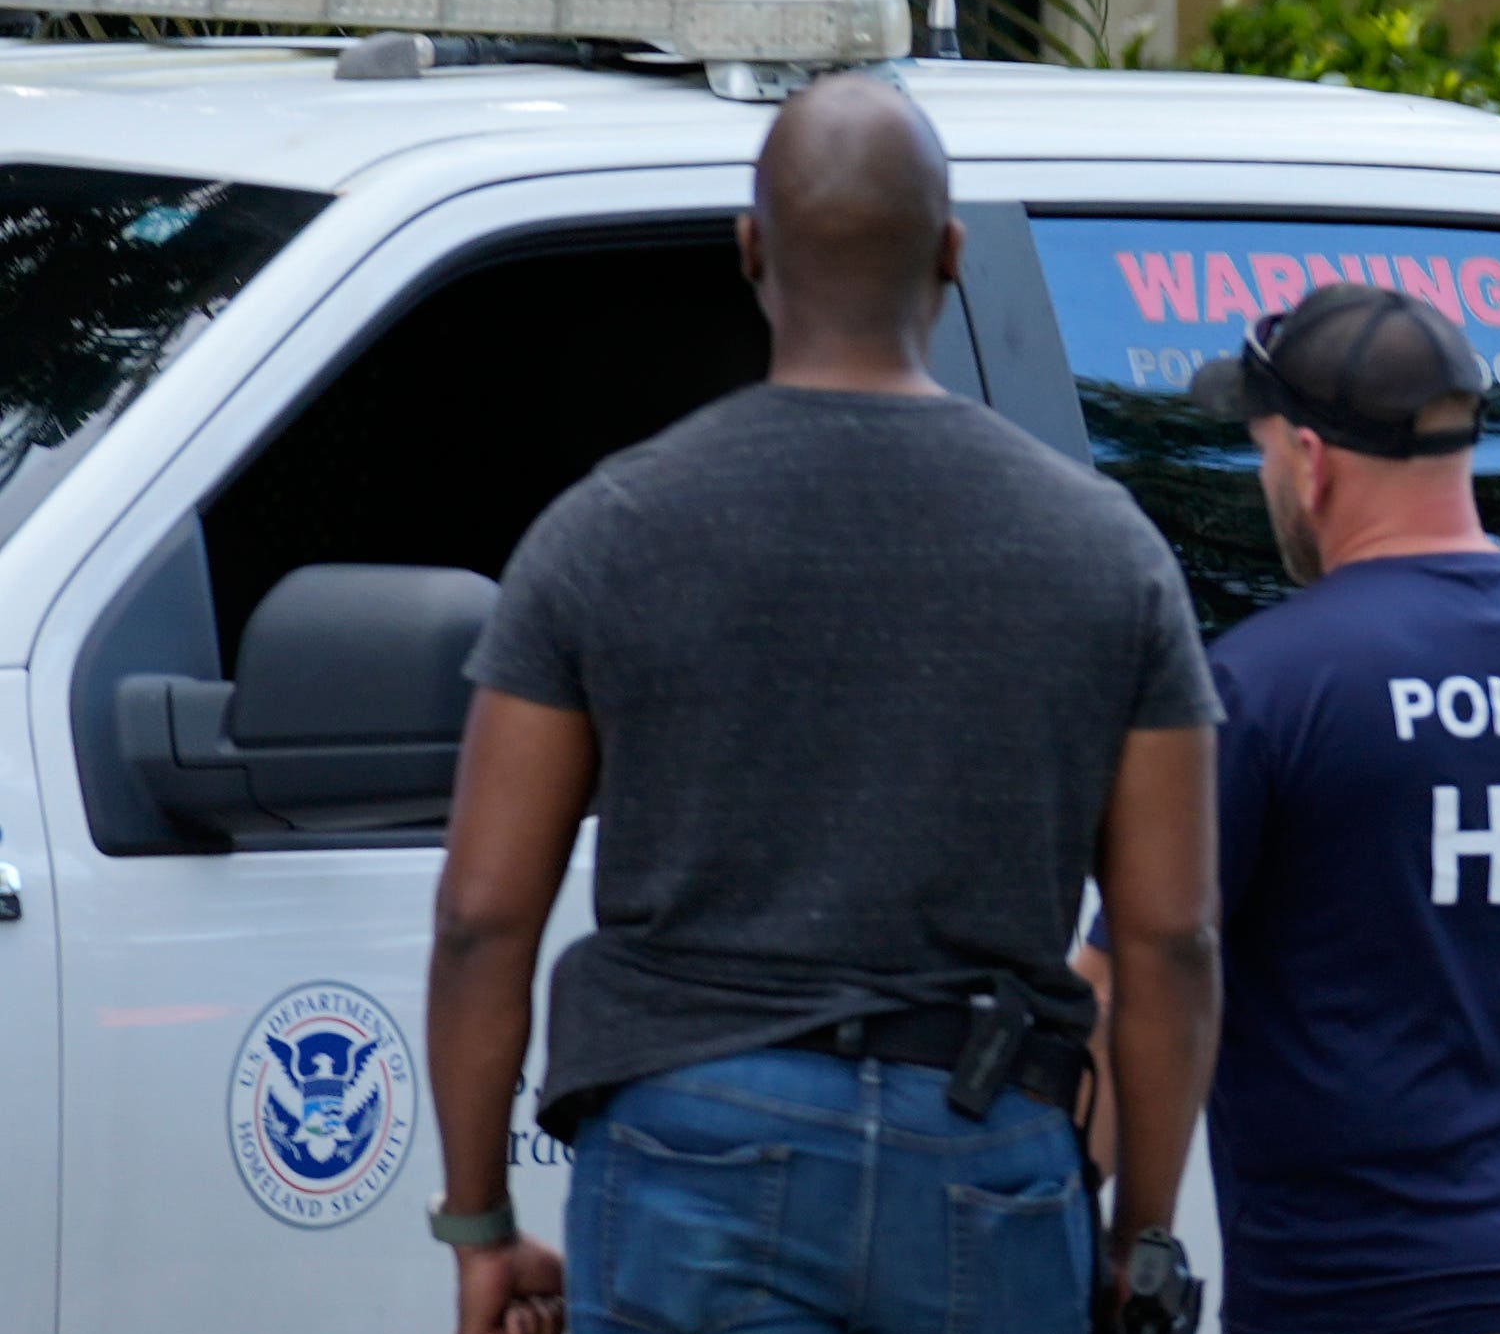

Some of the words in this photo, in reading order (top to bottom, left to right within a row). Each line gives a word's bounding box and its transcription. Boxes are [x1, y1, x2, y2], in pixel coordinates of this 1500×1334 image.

[267, 992, 395, 1049] DEPARTMENT
[390, 1052, 408, 1083] OF
[236, 1120, 324, 1218] HOMELAND
[330, 1115, 408, 1216] SECURITY
